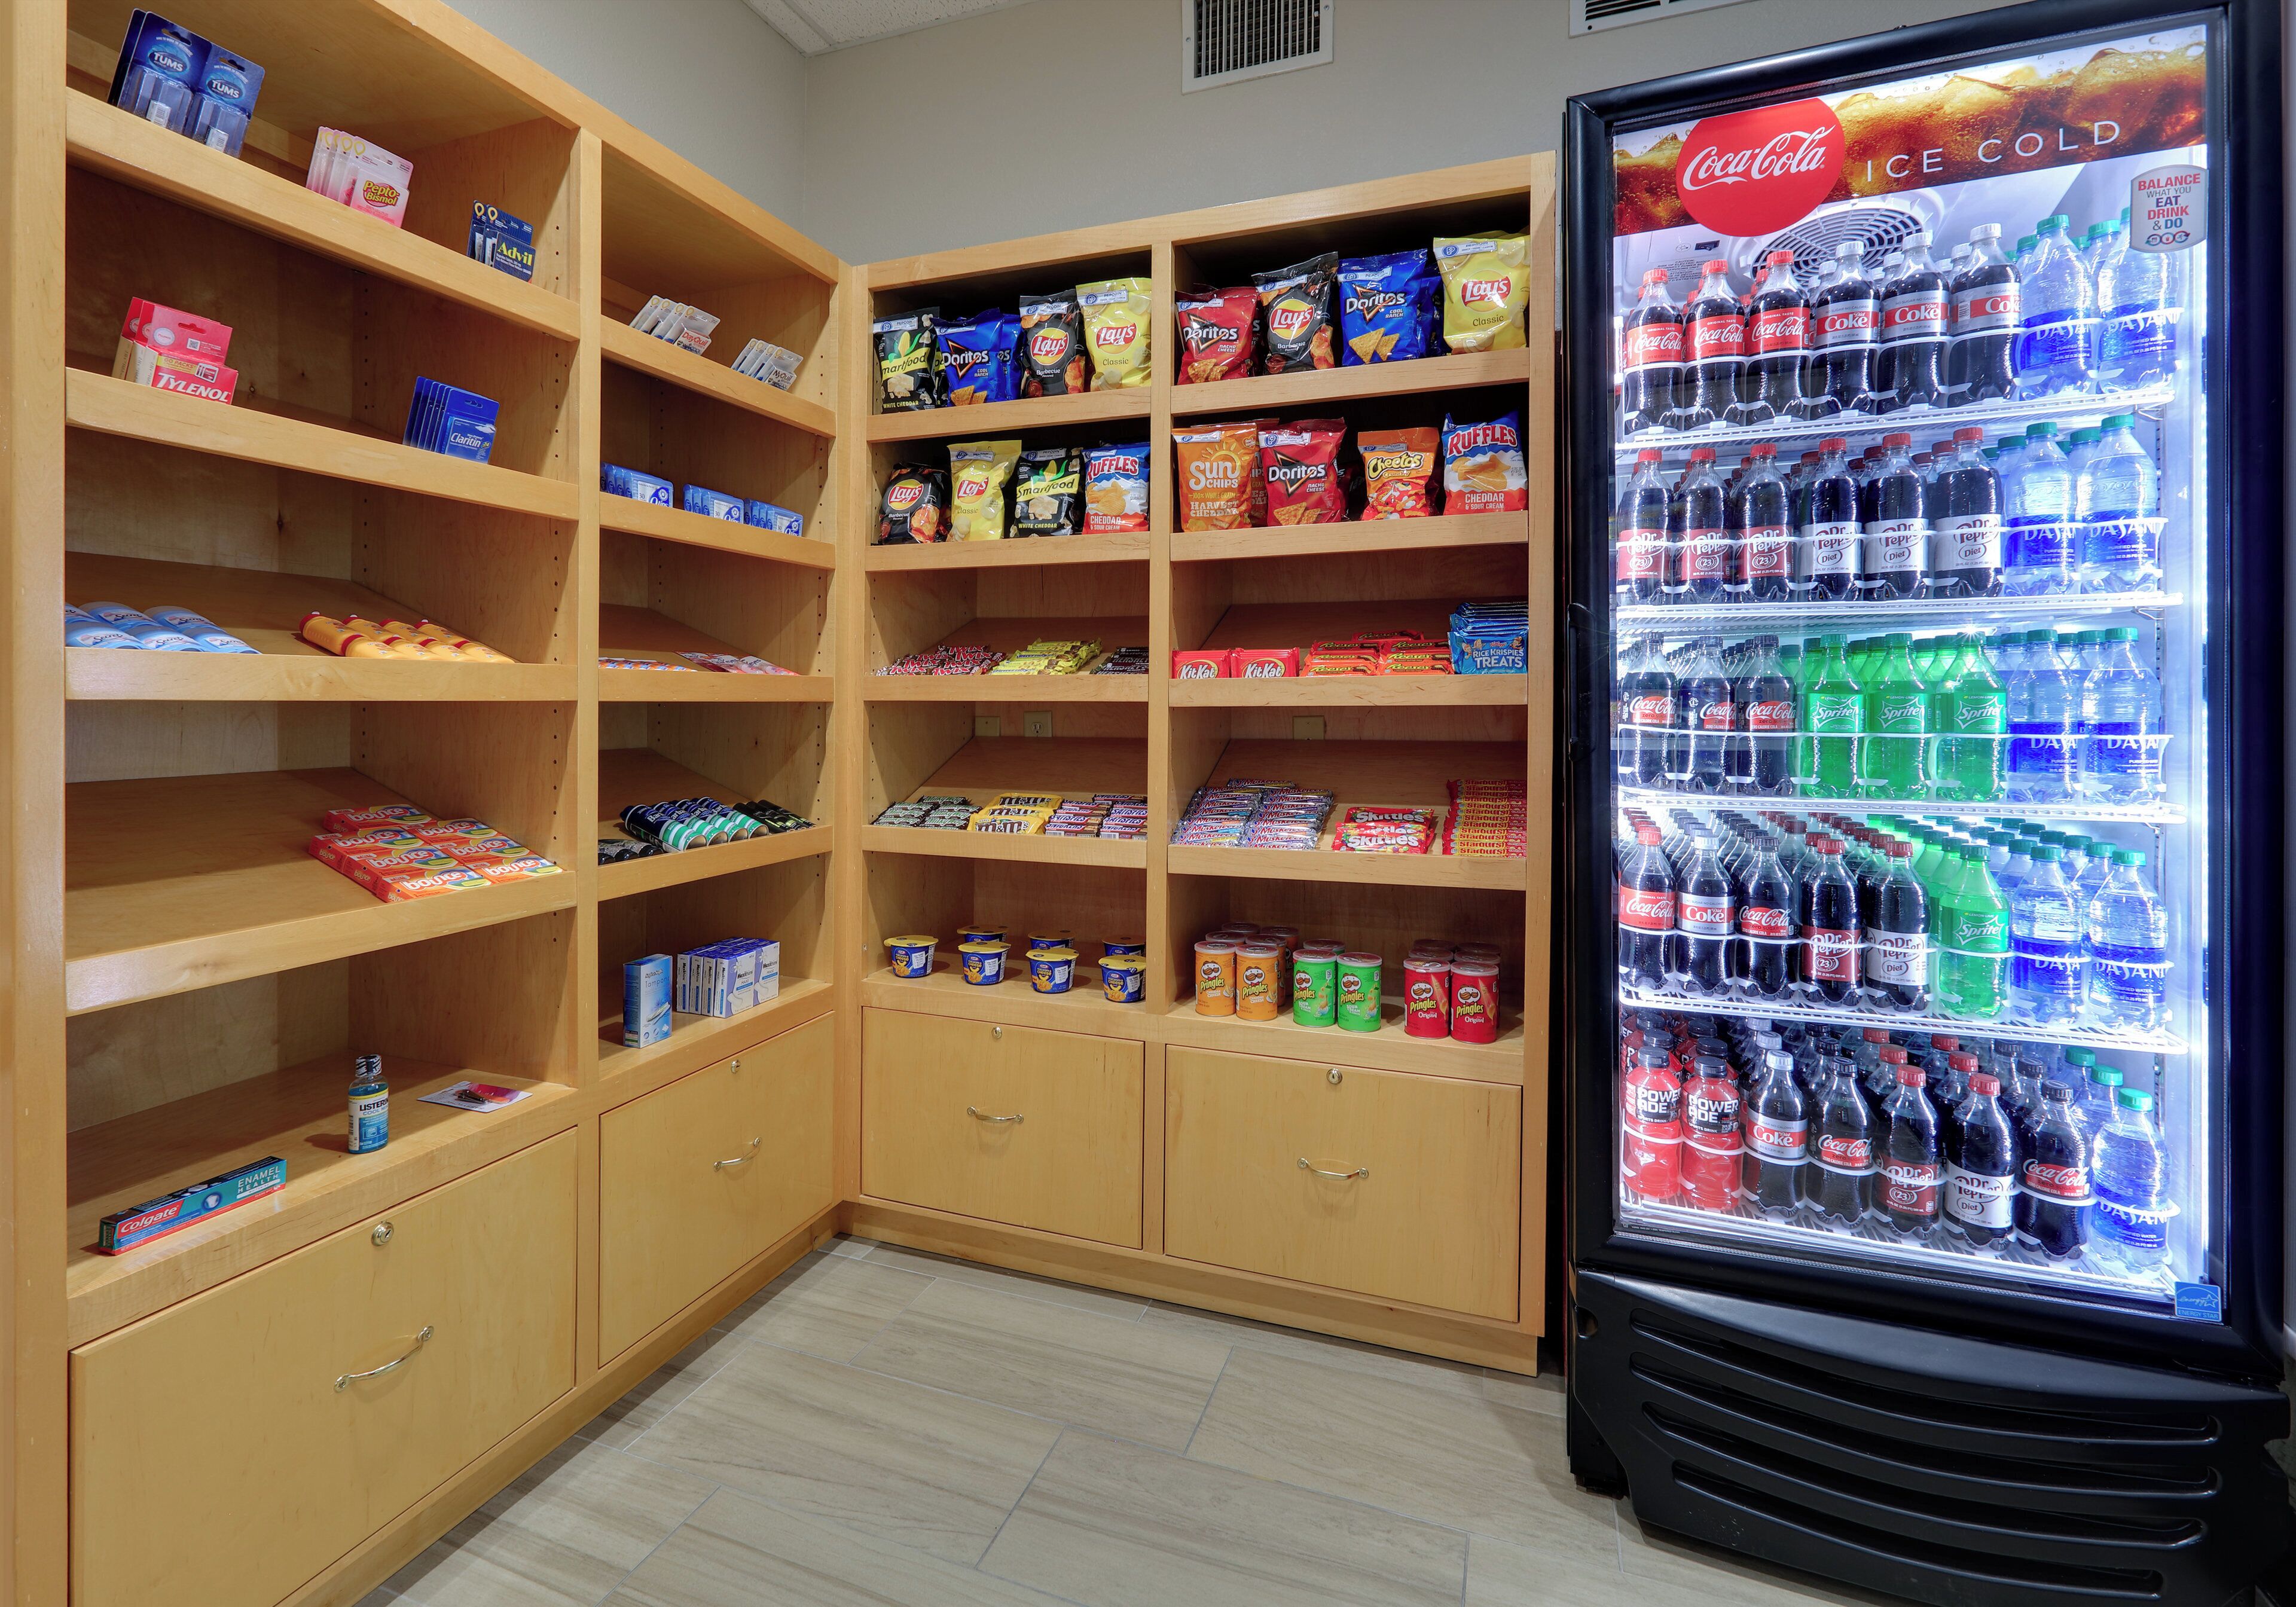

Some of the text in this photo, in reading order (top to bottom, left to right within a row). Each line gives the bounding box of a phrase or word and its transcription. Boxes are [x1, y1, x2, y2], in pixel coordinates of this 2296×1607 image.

[153, 51, 184, 72] TUMS
[212, 80, 240, 99] TUMS
[1683, 124, 1836, 191] Coca-Cola
[1867, 120, 2121, 182] ICE COLD
[363, 180, 400, 198] Pepto-
[2138, 173, 2201, 191] BALANCE
[366, 191, 398, 206] Bismol
[2147, 186, 2191, 198] WHAT YOU
[2147, 205, 2190, 220] DRINK
[2152, 217, 2183, 231] & DO
[497, 242, 533, 266] Advil
[1465, 278, 1509, 302] Lay's
[1346, 293, 1405, 313] Doritos
[1273, 308, 1312, 331] Lay's
[1473, 315, 1504, 326] Classic
[1824, 314, 1868, 332] Coke
[1894, 307, 1941, 324] Coke
[1098, 325, 1135, 346] Lay's
[1183, 327, 1238, 343] Doritos
[1694, 323, 1745, 349] Coca-Cola
[1752, 316, 1806, 342] Coca-Cola
[682, 331, 709, 347] DayQuil
[1033, 335, 1066, 358] Lay's
[1635, 331, 1682, 354] Coca-Cola
[942, 350, 989, 366] Doritos
[1103, 358, 1129, 366] Classic
[773, 370, 793, 382] NyQuil
[156, 372, 231, 402] TYLENOL
[450, 432, 481, 448] Claritin
[1448, 425, 1517, 457] RUFFLES
[1086, 456, 1139, 481] RUFFLES
[1269, 463, 1325, 482] Doritos
[1368, 453, 1423, 479] Cheetos
[1189, 461, 1241, 491] Sun
[1206, 478, 1238, 488] CHIPS
[890, 486, 921, 503] Lay's
[1016, 478, 1074, 499] Smartfood
[1190, 500, 1239, 510] HARVEST
[1465, 493, 1504, 503] CHEDDAR
[1090, 515, 1121, 525] CHEDDAR
[1190, 508, 1239, 517] CHEDDAR
[1821, 552, 1838, 564] Diet
[1889, 549, 1906, 561] Diet
[1964, 546, 1982, 558] Diet
[1635, 555, 1647, 566] 23
[1702, 558, 1713, 566] 23
[1758, 555, 1771, 566] 23
[93, 633, 123, 643] Secret
[156, 636, 184, 645] Secret
[1473, 650, 1489, 658] RICE
[1474, 656, 1523, 668] TREATS
[1180, 664, 1216, 679] KitKat
[1243, 663, 1282, 678] KitKat
[1629, 696, 1678, 714] Coca-Cola
[1746, 701, 1796, 720] Coca-Cola
[1818, 705, 1854, 720] Sprite
[1882, 704, 1919, 720] Sprite
[1961, 704, 1999, 720] Sprite
[349, 807, 405, 821] bounce
[1355, 811, 1424, 823] Skittles
[420, 821, 472, 837] bounce
[335, 830, 394, 847] bounce
[1347, 835, 1419, 848] Skittles
[452, 839, 503, 856] bounce
[368, 850, 429, 868] bounce
[487, 858, 536, 876] bounce
[402, 871, 462, 890] bounce
[1626, 898, 1674, 918] Coca-Cola
[1686, 906, 1726, 923] Coke
[1739, 905, 1793, 927] Coca-Cola
[1825, 932, 1842, 943] Dr
[1960, 923, 2000, 937] Sprite
[1895, 936, 1912, 948] Dr
[1819, 959, 1831, 968] 23
[1886, 964, 1903, 973] Diet
[1199, 977, 1225, 992] Pringles
[1241, 983, 1268, 1000] Pringles
[1294, 988, 1315, 1001] Pringles
[1340, 991, 1365, 1006] Pringles
[1409, 998, 1437, 1014] Pringles
[1455, 1003, 1484, 1019] Pringles
[1638, 1101, 1668, 1114] ADE
[1689, 1094, 1739, 1113] POWER
[1688, 1107, 1718, 1123] ADE
[1752, 1125, 1794, 1147] Coke
[1818, 1134, 1873, 1157] Coca-Cola
[237, 1166, 280, 1188] ENAMEL
[1904, 1166, 1922, 1178] Dr
[2022, 1159, 2089, 1186] Coca-Cola
[237, 1174, 279, 1194] HEALTH
[1970, 1177, 1989, 1190] Dr
[2037, 1184, 2050, 1193] CALORIE
[1897, 1191, 1908, 1201] 23
[1961, 1202, 1978, 1211] Diet
[121, 1205, 178, 1234] Colgate
